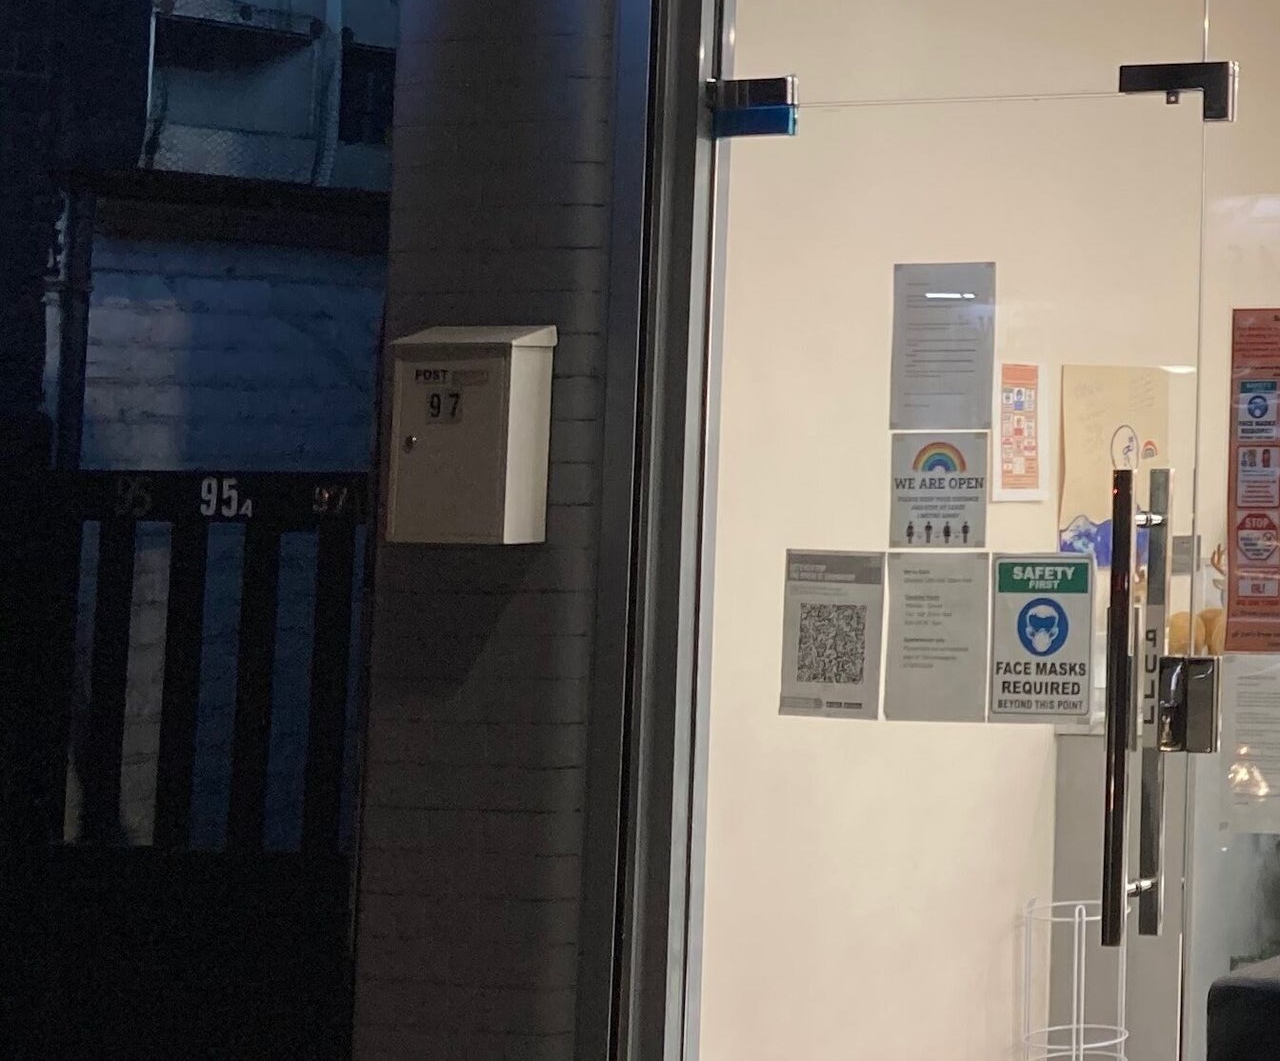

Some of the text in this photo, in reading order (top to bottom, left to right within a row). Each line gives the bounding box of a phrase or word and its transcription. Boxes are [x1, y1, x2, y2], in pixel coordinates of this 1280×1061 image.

[415, 368, 449, 383] POST
[429, 392, 461, 419] 97
[894, 477, 984, 490] WE ARE OPEN
[1245, 517, 1269, 529] STOP
[1011, 566, 1075, 581] SAFETY
[1028, 580, 1060, 590] FIRST
[995, 661, 1087, 677] FACE MASKS
[1001, 681, 1081, 696] REQUIRED
[997, 699, 1084, 711] BEYOND THIS POINT
